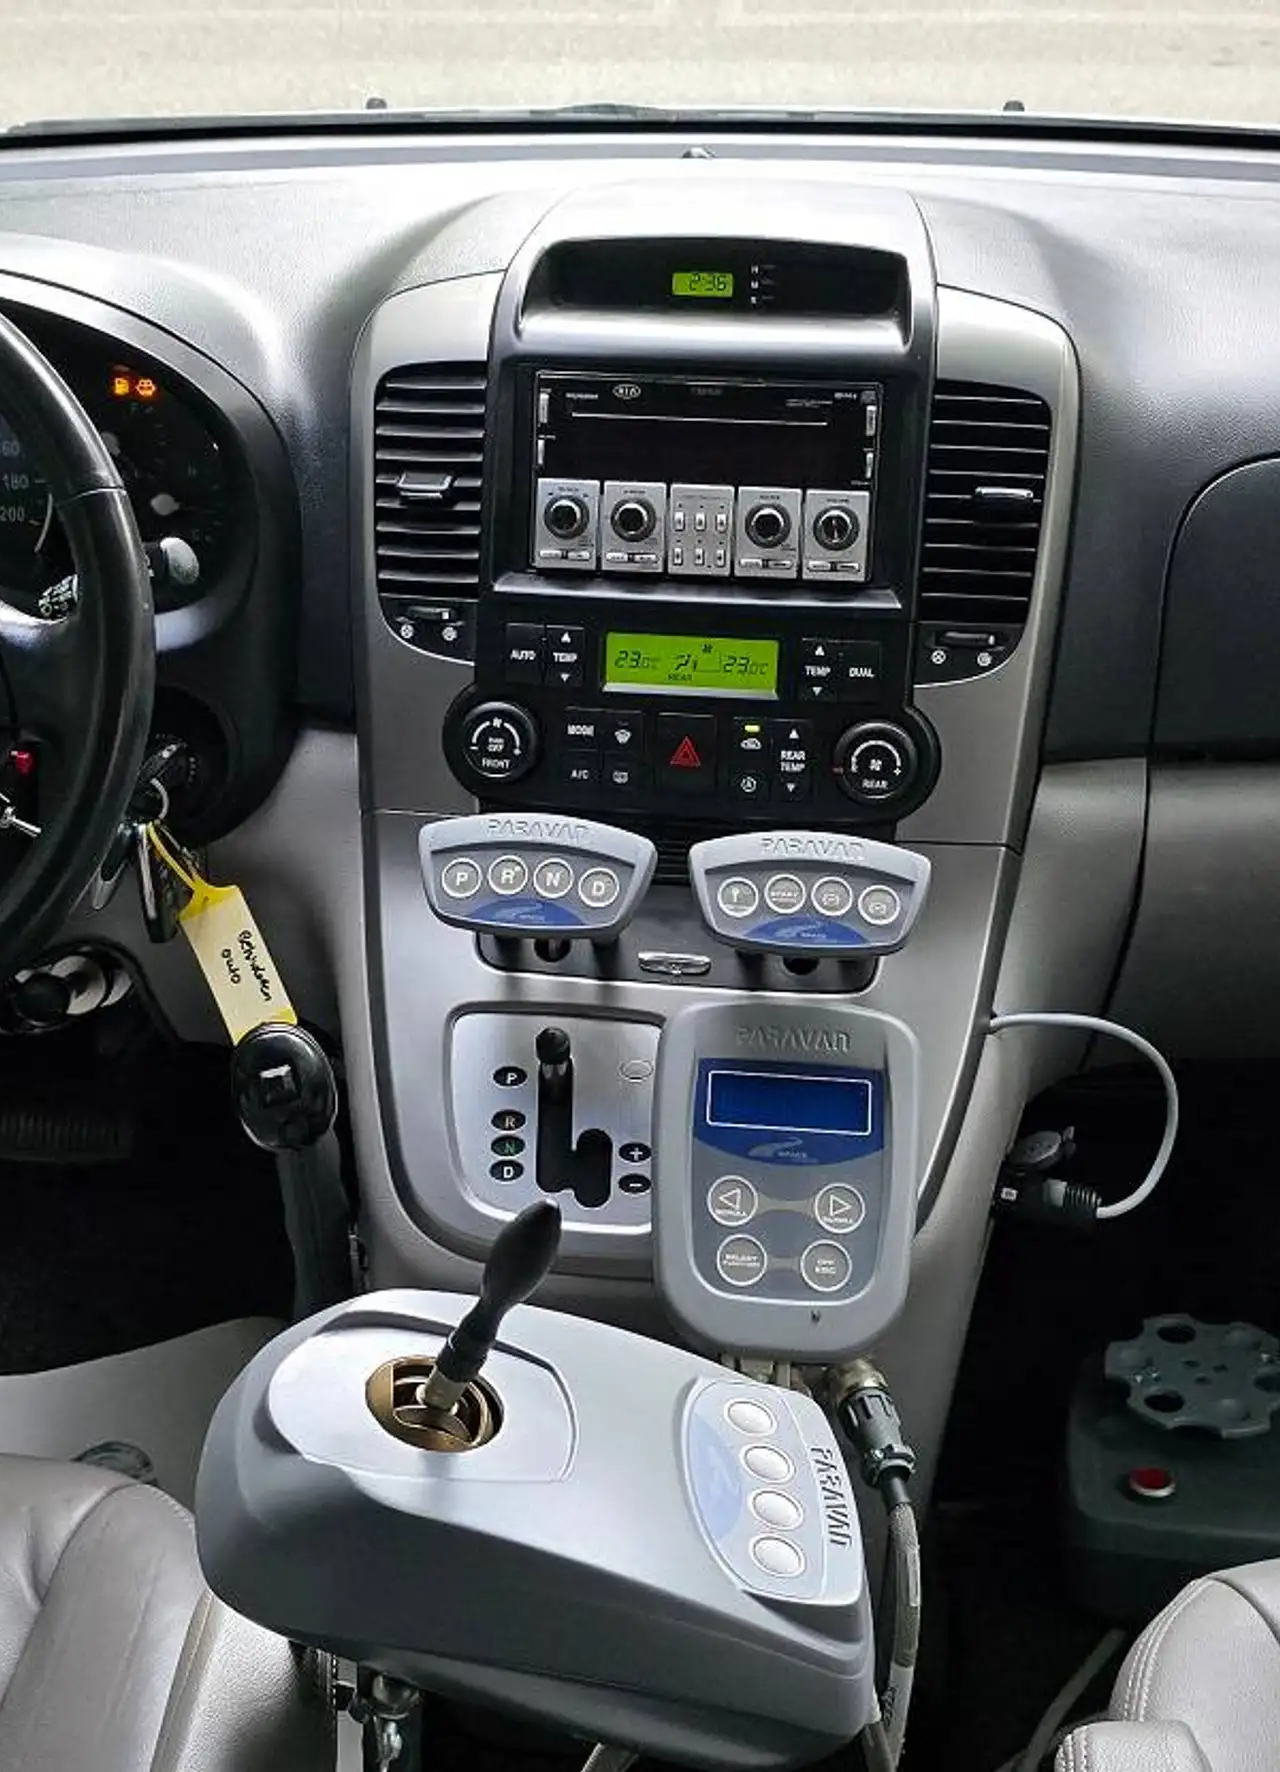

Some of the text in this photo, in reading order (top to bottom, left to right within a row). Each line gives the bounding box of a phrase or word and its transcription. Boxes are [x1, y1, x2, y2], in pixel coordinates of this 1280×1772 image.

[0, 506, 25, 523] 200
[510, 651, 536, 661] AUTO
[552, 652, 578, 663] TEMP
[804, 665, 831, 677] TEMP
[849, 667, 875, 678] DUAL
[567, 724, 595, 737] MODE
[780, 750, 806, 761] REAR
[482, 757, 511, 769] FRONT
[781, 762, 806, 772] TEMP
[571, 770, 589, 780] A/C
[862, 779, 889, 790] REAR
[486, 818, 589, 842] PARAVAN
[759, 836, 866, 862] PARAVAN
[455, 870, 605, 897] P R N D
[735, 1024, 851, 1053] PARAVAN
[506, 1072, 517, 1085] P
[504, 1116, 516, 1129] R
[504, 1143, 516, 1156] N
[503, 1166, 514, 1179] D
[810, 1446, 854, 1551] PARAVAN
